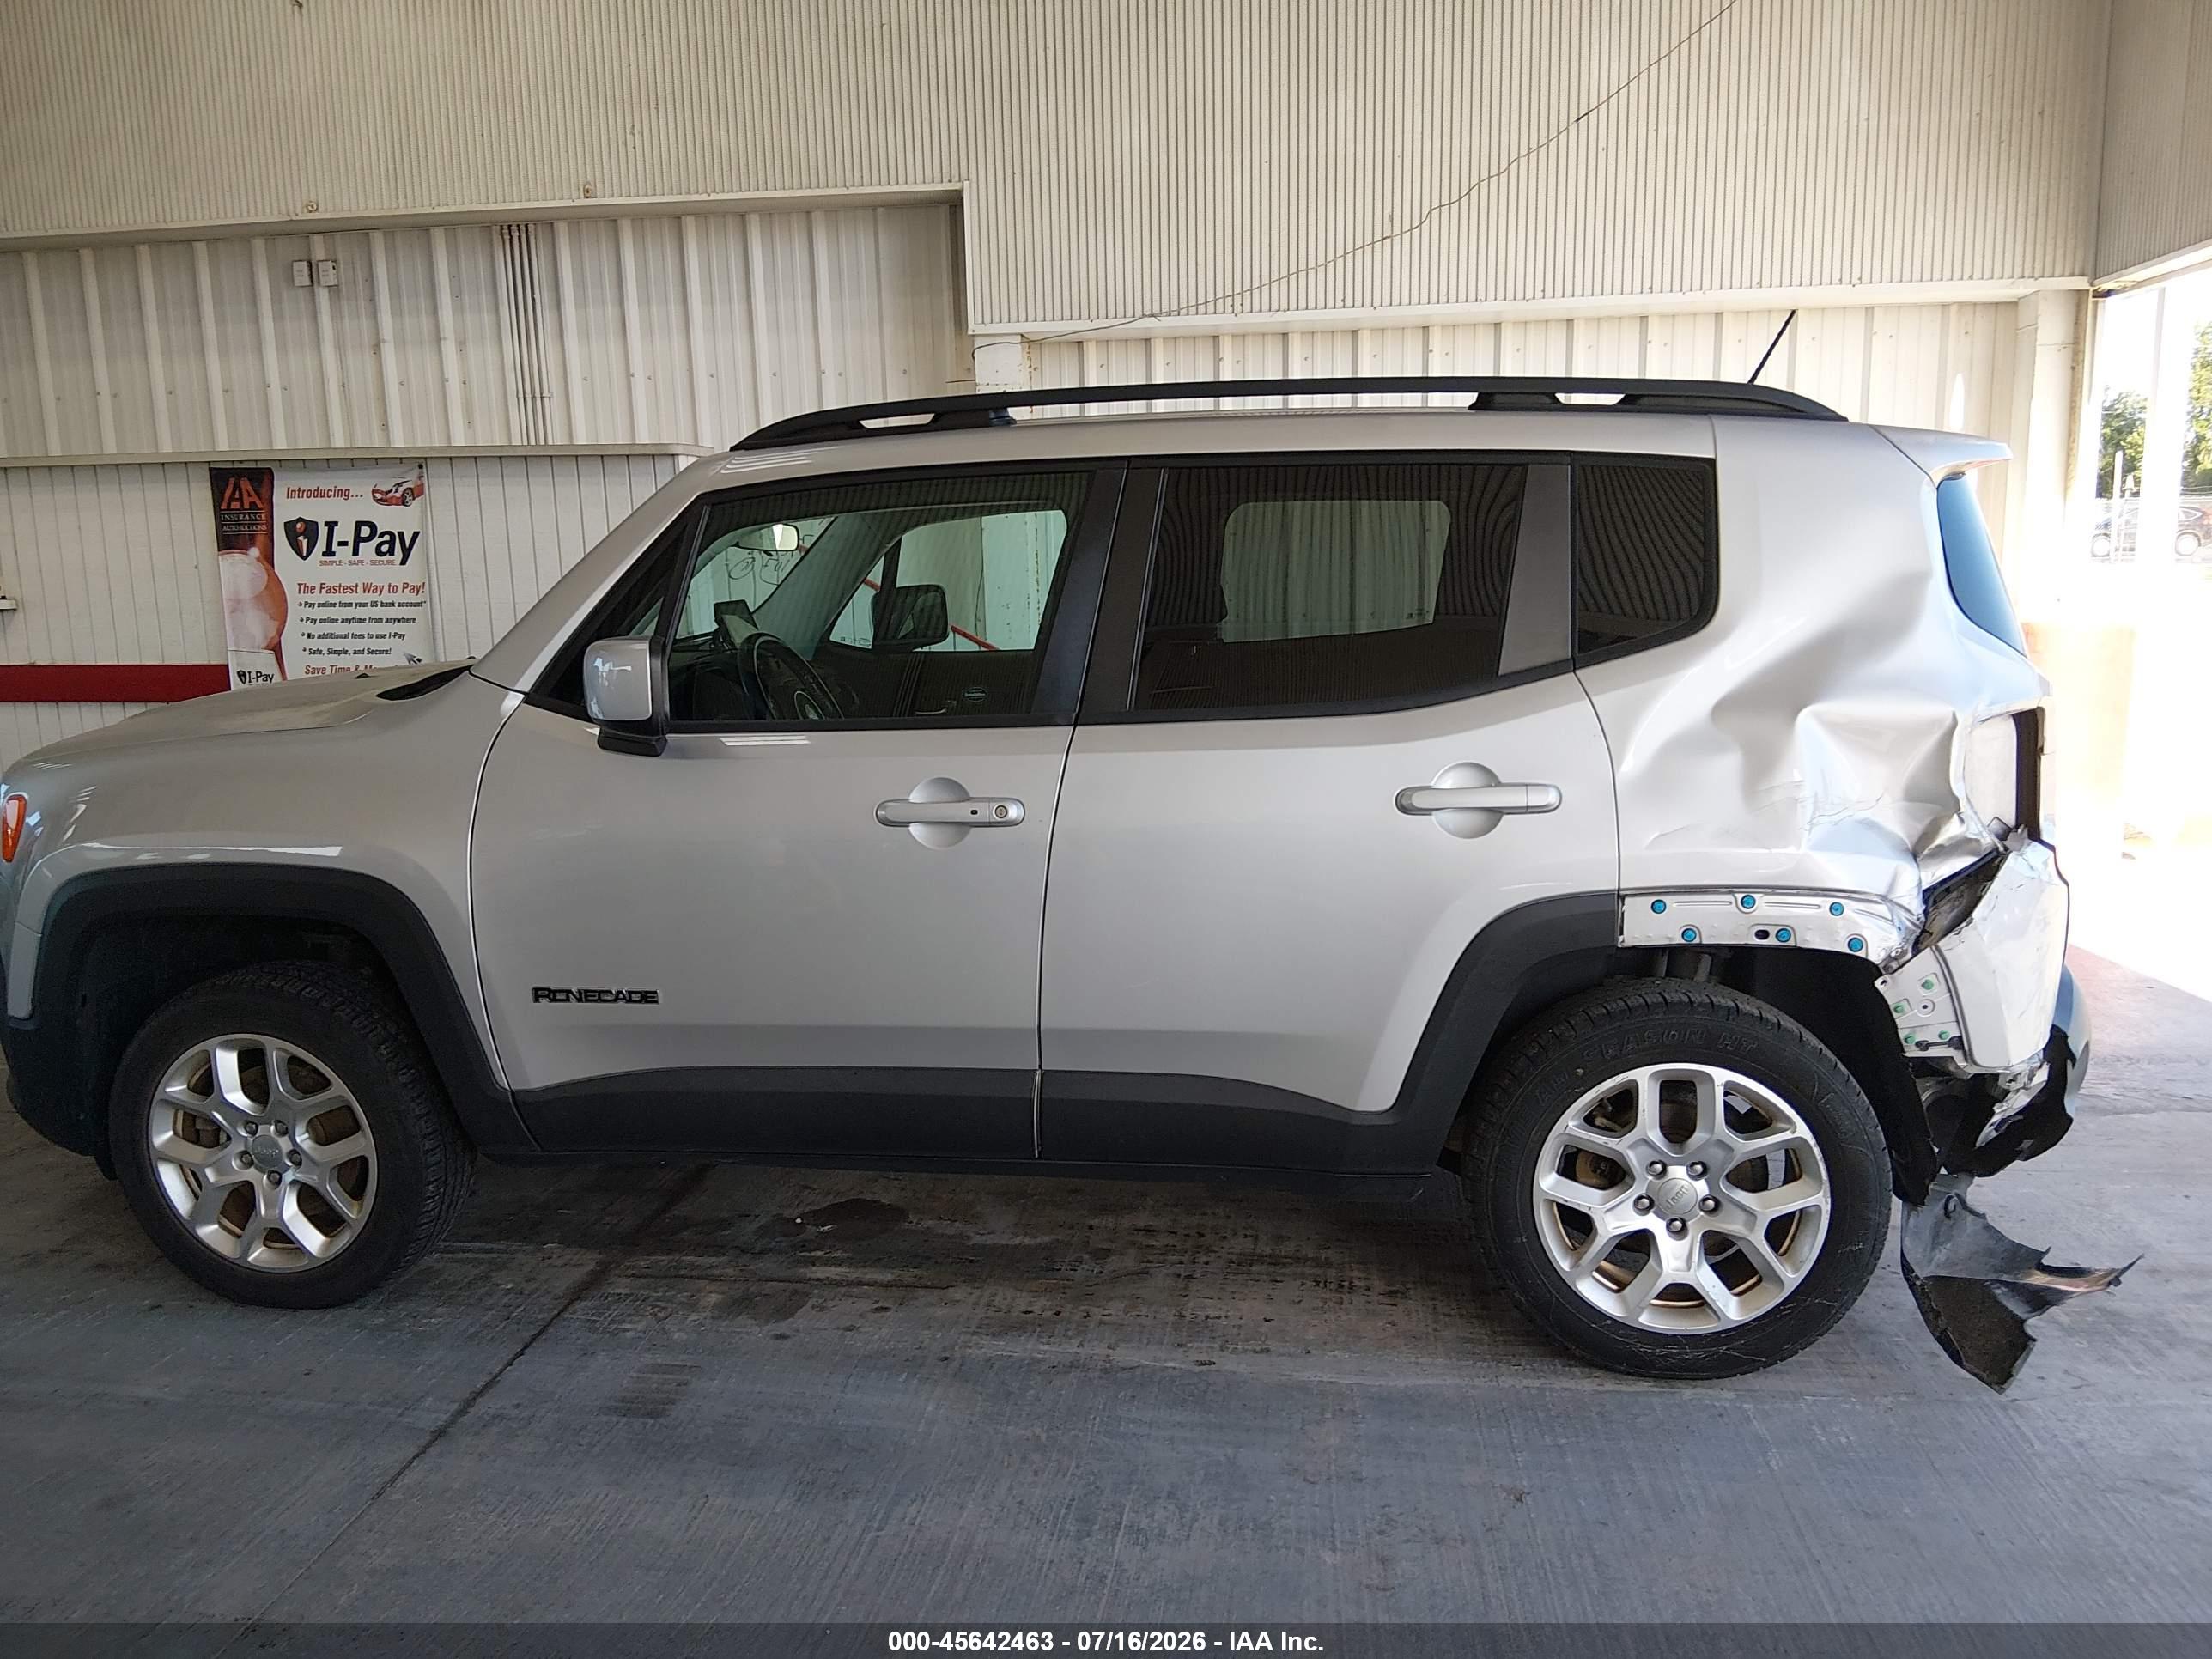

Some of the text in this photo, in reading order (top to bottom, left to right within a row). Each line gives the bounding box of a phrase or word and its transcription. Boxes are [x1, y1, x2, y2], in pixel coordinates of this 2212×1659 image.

[286, 486, 364, 500] Introducing...
[321, 520, 421, 566] I-Pay
[296, 581, 426, 597] The Fastest Way to Pay!
[303, 601, 316, 610] Pay
[305, 617, 317, 626] Pay
[340, 616, 366, 626] anytime
[385, 617, 417, 626] anywhere
[307, 632, 315, 640] No
[317, 632, 350, 640] additional
[351, 632, 366, 640] fees
[389, 632, 407, 642] I-Pay
[308, 647, 325, 656] Safe,
[326, 647, 351, 657] Simple,
[304, 665, 326, 675] Save
[247, 671, 275, 684] I-Pay
